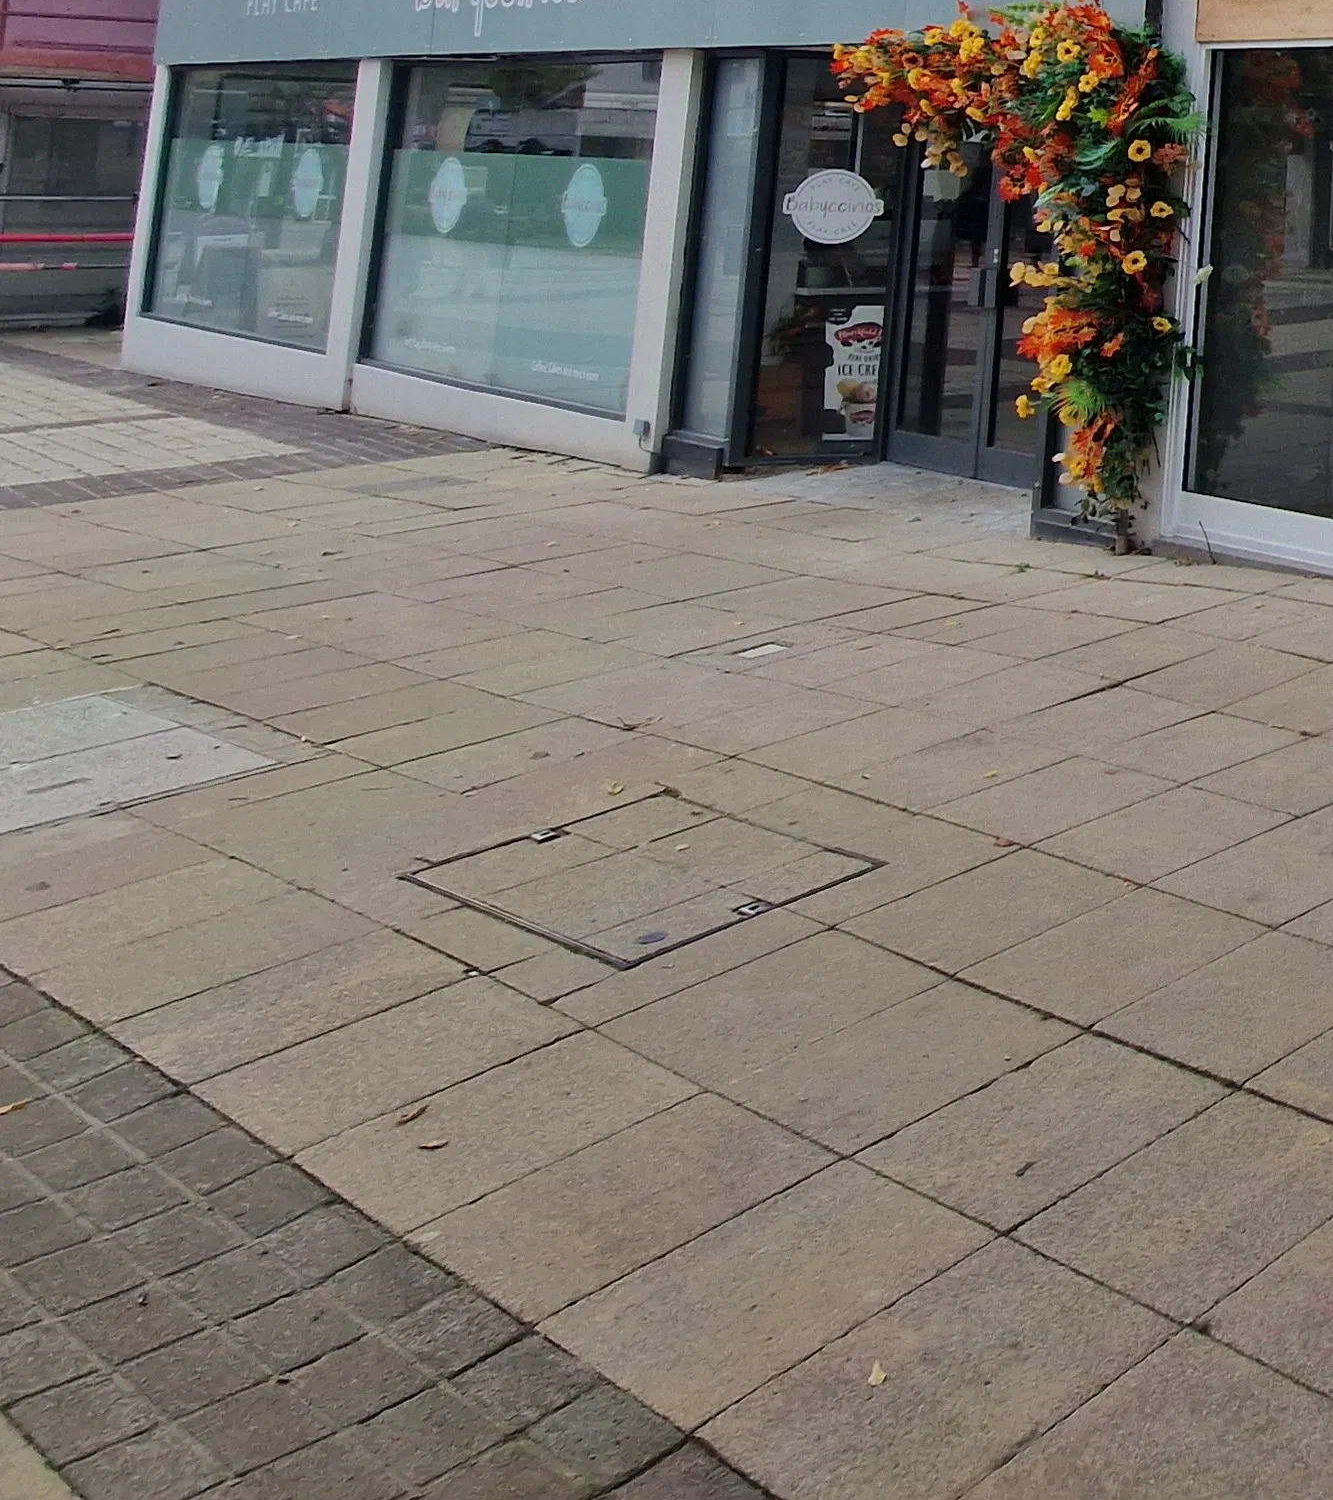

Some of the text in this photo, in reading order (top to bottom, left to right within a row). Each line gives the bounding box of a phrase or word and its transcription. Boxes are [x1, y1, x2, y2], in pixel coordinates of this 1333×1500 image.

[786, 195, 882, 219] Babyccinos
[838, 364, 877, 376] ICE CRE
